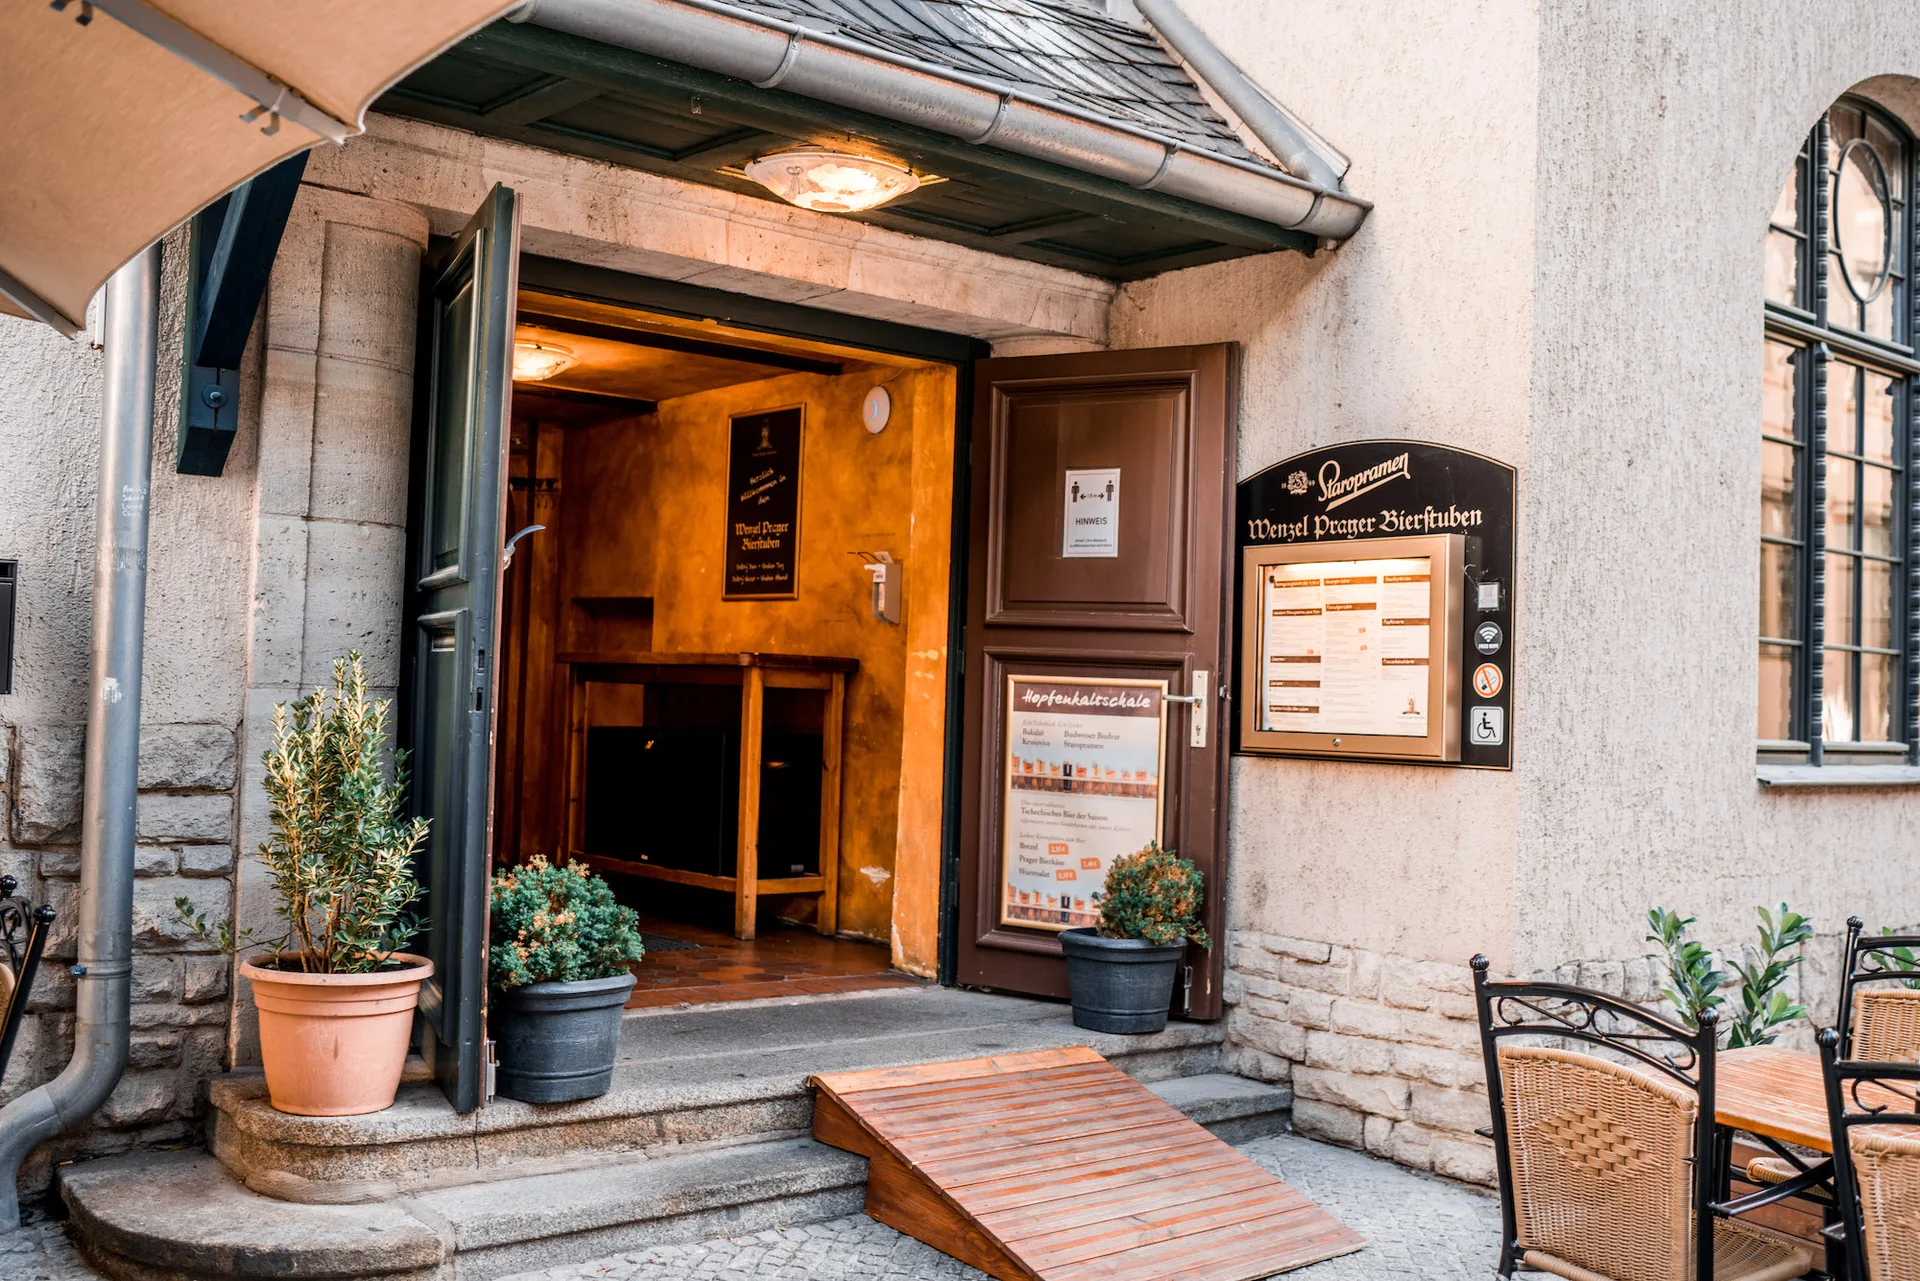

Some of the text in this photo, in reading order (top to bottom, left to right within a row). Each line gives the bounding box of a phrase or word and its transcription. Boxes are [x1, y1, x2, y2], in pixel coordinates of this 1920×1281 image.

[1318, 452, 1411, 512] Staropramen
[1075, 517, 1108, 525] HINWEIS
[1248, 514, 1309, 542] Wenzel
[1314, 514, 1376, 540] Prager
[735, 521, 789, 538] Wenzel Prager
[1022, 688, 1151, 708] Hopfenkaltschale
[1063, 730, 1121, 741] Budweiser Budvar
[1063, 740, 1104, 750] Staropramen
[1020, 806, 1108, 821] Tschechisches Bier der Saison
[1019, 854, 1038, 865] Prager
